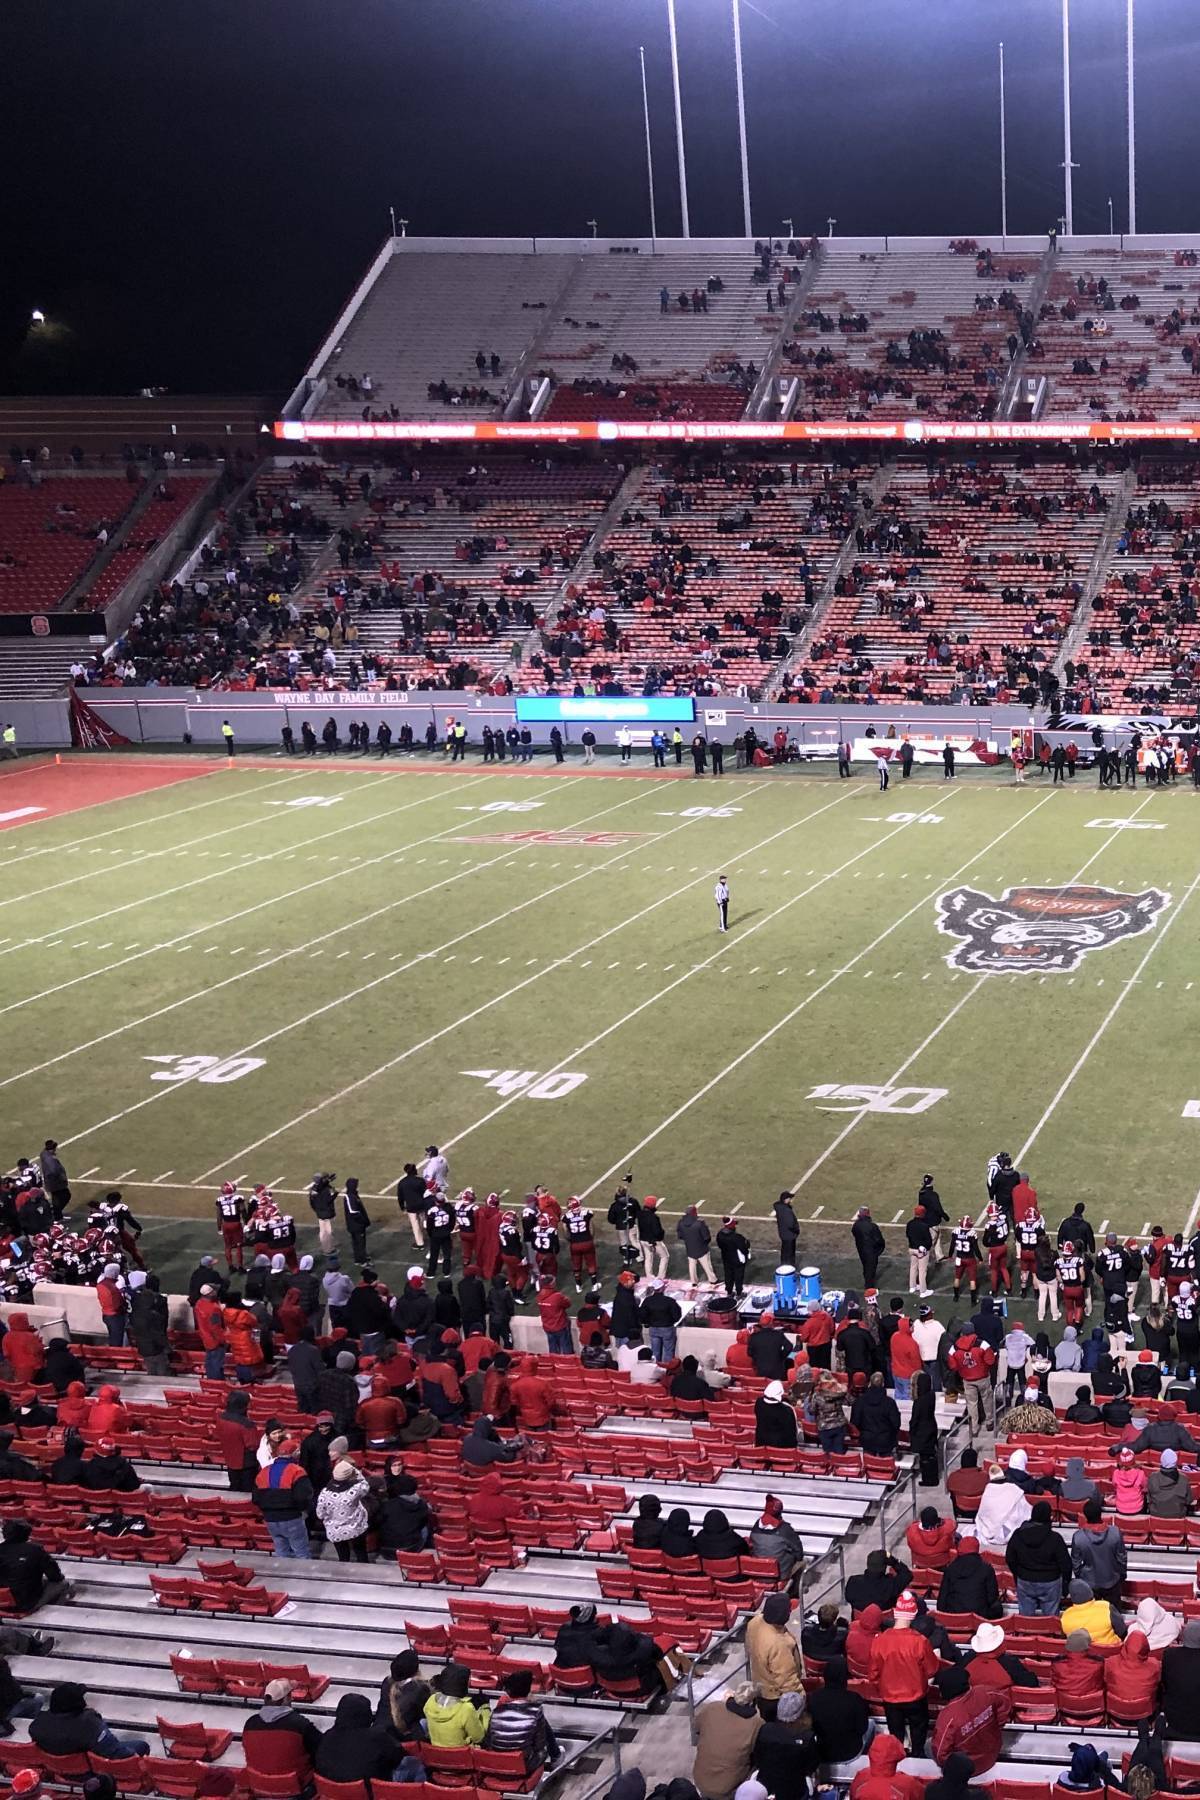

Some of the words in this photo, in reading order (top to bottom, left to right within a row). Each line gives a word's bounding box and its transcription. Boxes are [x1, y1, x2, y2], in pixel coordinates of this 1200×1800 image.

[274, 693, 311, 703] WAYNE
[315, 693, 335, 703] DAY
[339, 692, 376, 703] FAMILY
[380, 692, 408, 703] FIELD
[432, 829, 661, 847] ACC
[1022, 897, 1046, 907] NC
[1047, 900, 1105, 912] STATE
[150, 1055, 267, 1083] 30
[483, 1069, 589, 1099] 40
[222, 1205, 236, 1216] 21
[273, 1226, 290, 1240] 93
[570, 1221, 586, 1233] 52
[535, 1237, 550, 1249] 43
[1022, 1233, 1037, 1244] 92
[956, 1240, 970, 1252] 33
[1106, 1258, 1122, 1271] 76
[1170, 1257, 1185, 1268] 74
[1061, 1268, 1077, 1280] 30
[1176, 1308, 1192, 1320] 26
